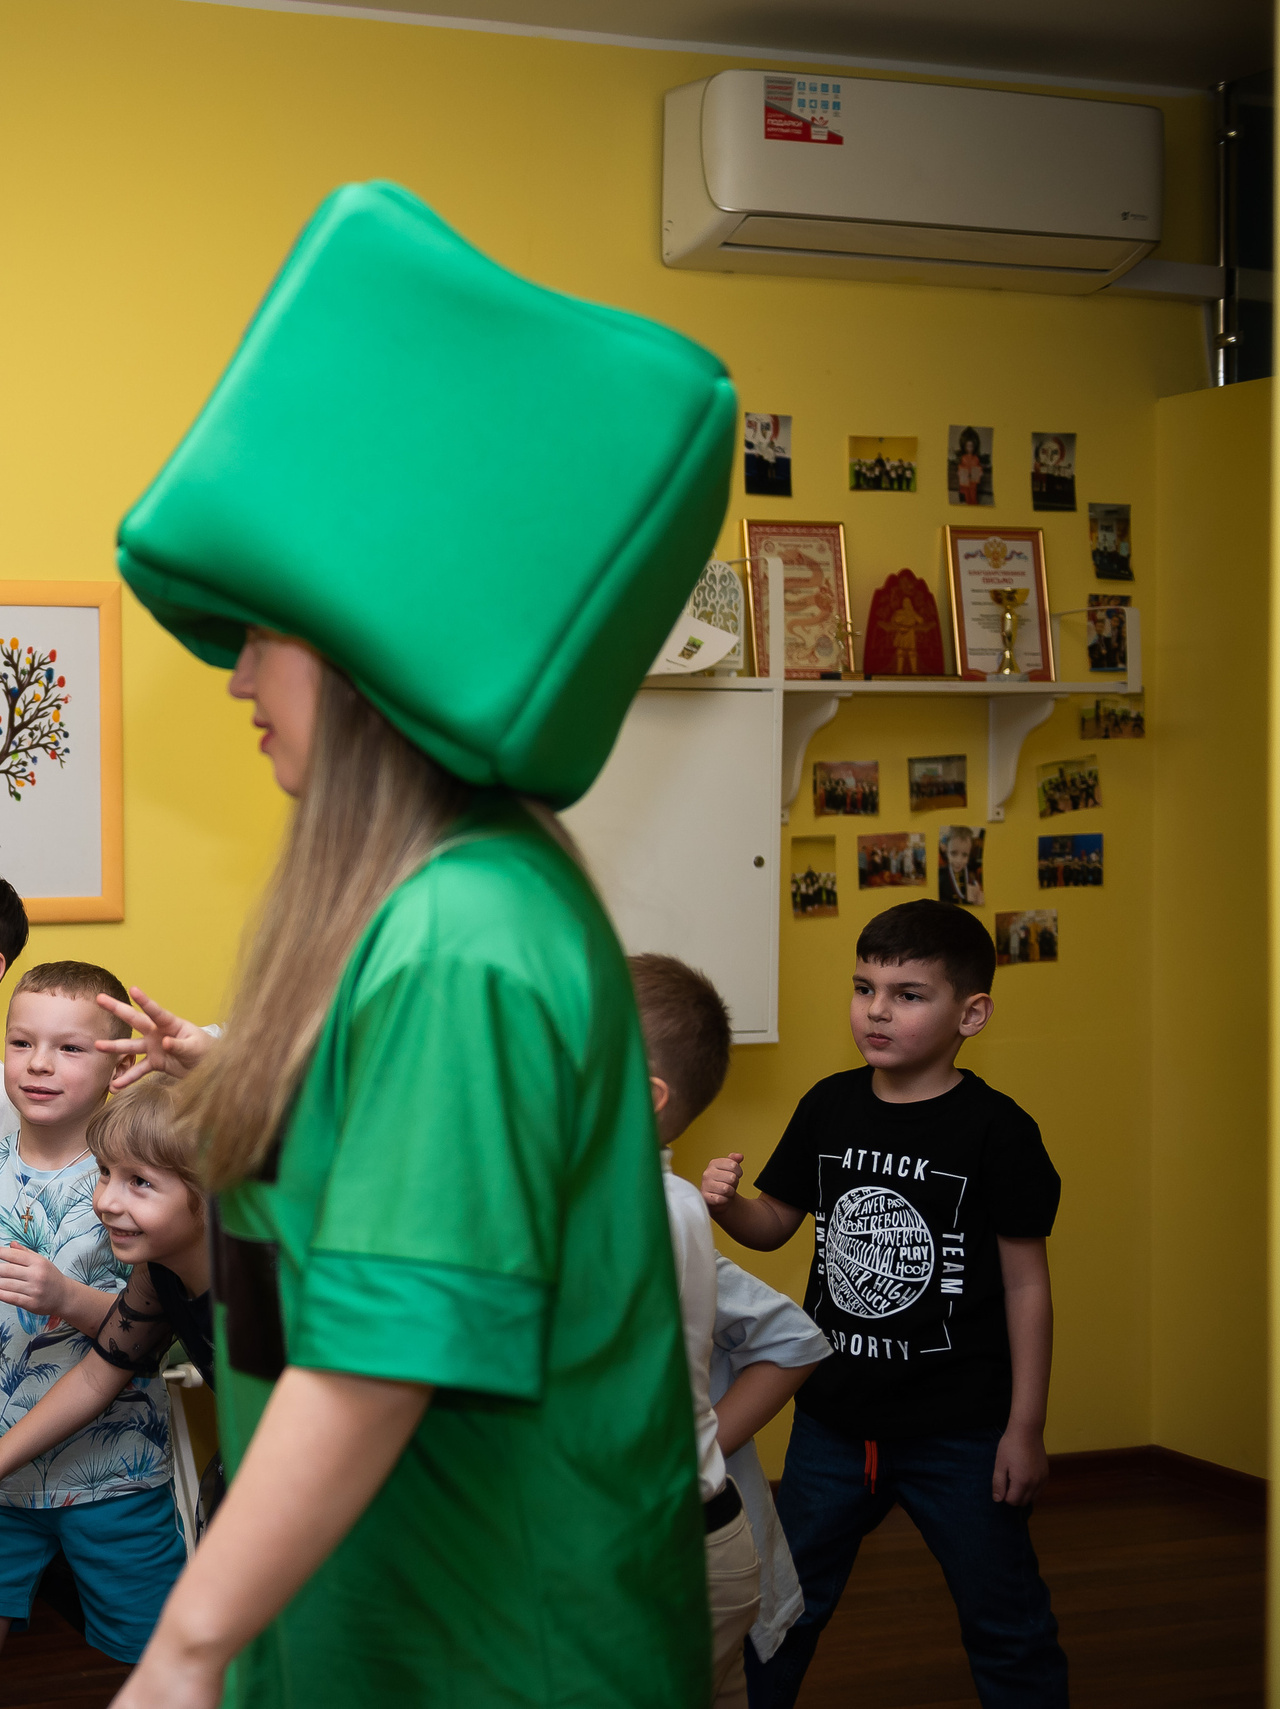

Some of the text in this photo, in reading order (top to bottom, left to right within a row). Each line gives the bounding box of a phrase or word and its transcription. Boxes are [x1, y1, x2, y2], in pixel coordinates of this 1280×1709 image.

[841, 1148, 930, 1181] ATTACK
[841, 1208, 922, 1232] SPORT REBOUND
[848, 1195, 886, 1218] PLAYER
[815, 1210, 826, 1275] GAME
[871, 1229, 931, 1247] POWERFUL
[899, 1246, 929, 1261] PLAY
[835, 1232, 897, 1277] PROFESSIONAL
[895, 1261, 931, 1278] HOOP
[940, 1232, 965, 1294] TEAM
[861, 1283, 891, 1314] LUCK
[874, 1275, 916, 1307] HIGH
[831, 1329, 909, 1360] SPORTY
